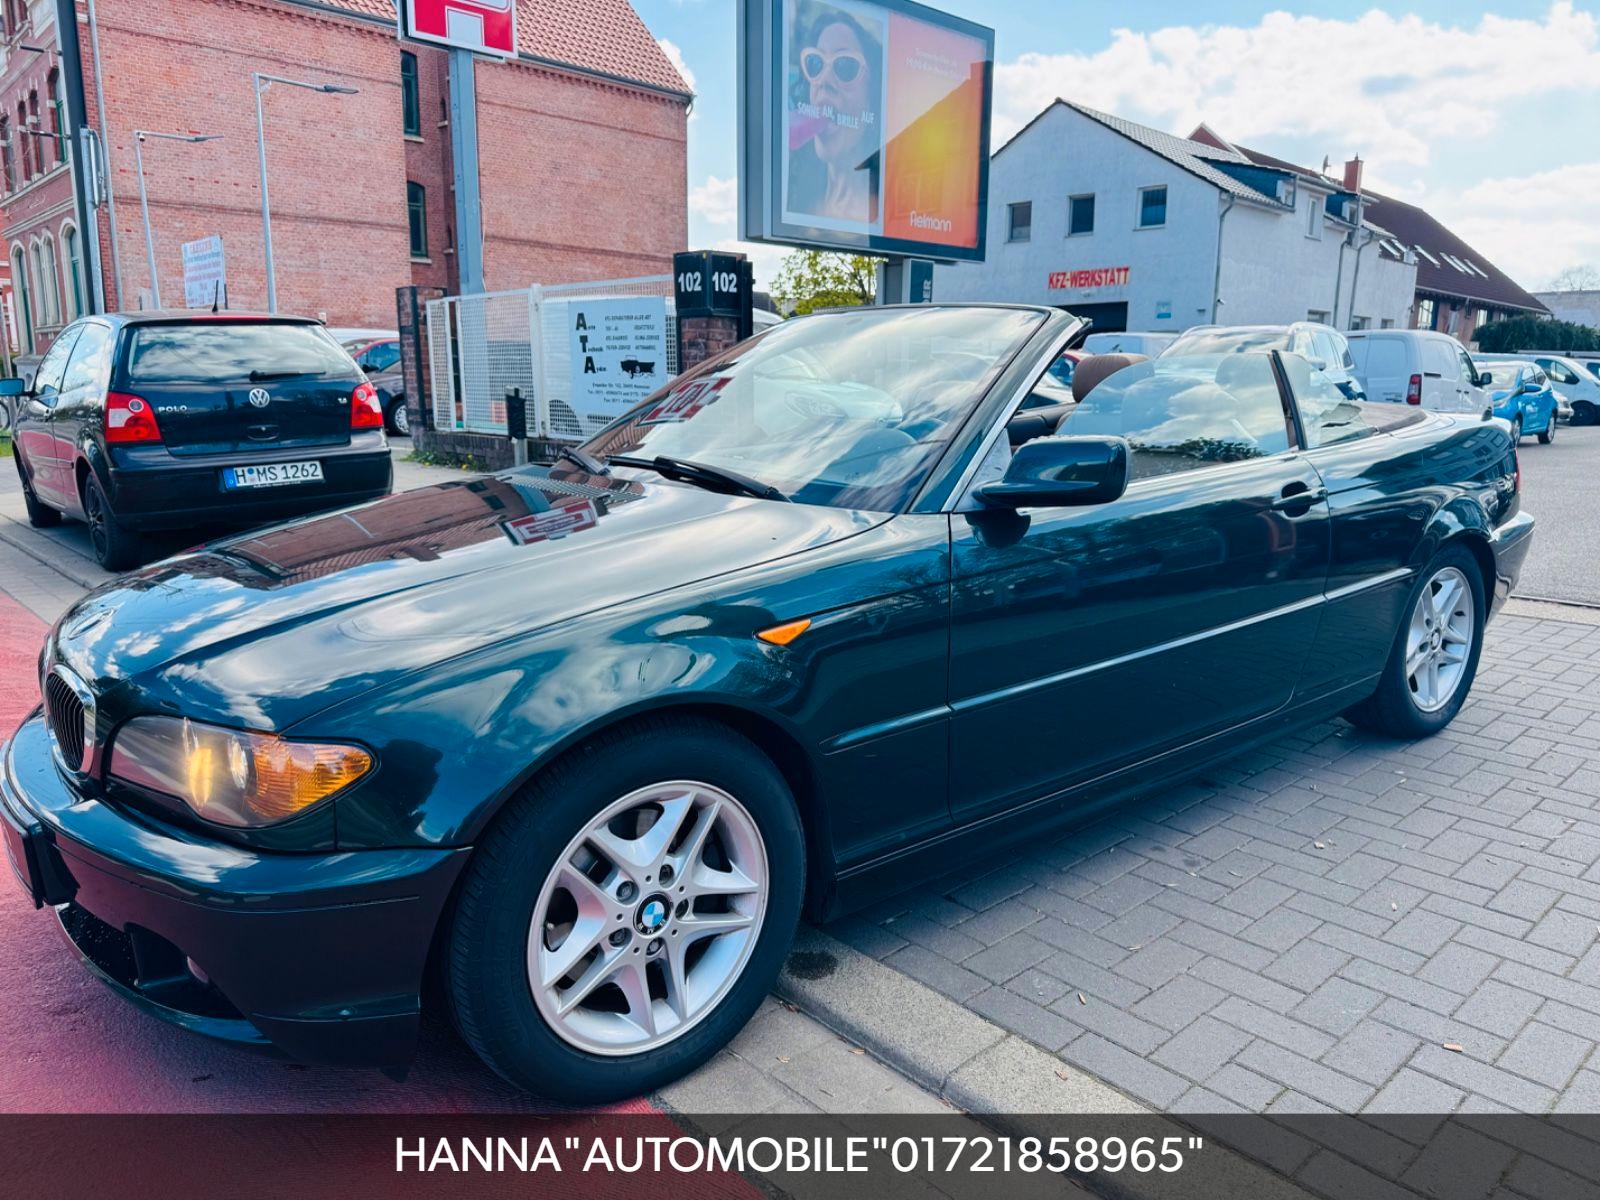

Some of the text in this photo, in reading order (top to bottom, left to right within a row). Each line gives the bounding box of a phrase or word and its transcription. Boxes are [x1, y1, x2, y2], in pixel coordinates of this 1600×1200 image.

[678, 271, 702, 293] 102
[712, 271, 738, 293] 102
[1048, 266, 1130, 289] KFZ-WERKSTATT
[158, 405, 188, 413] POLO
